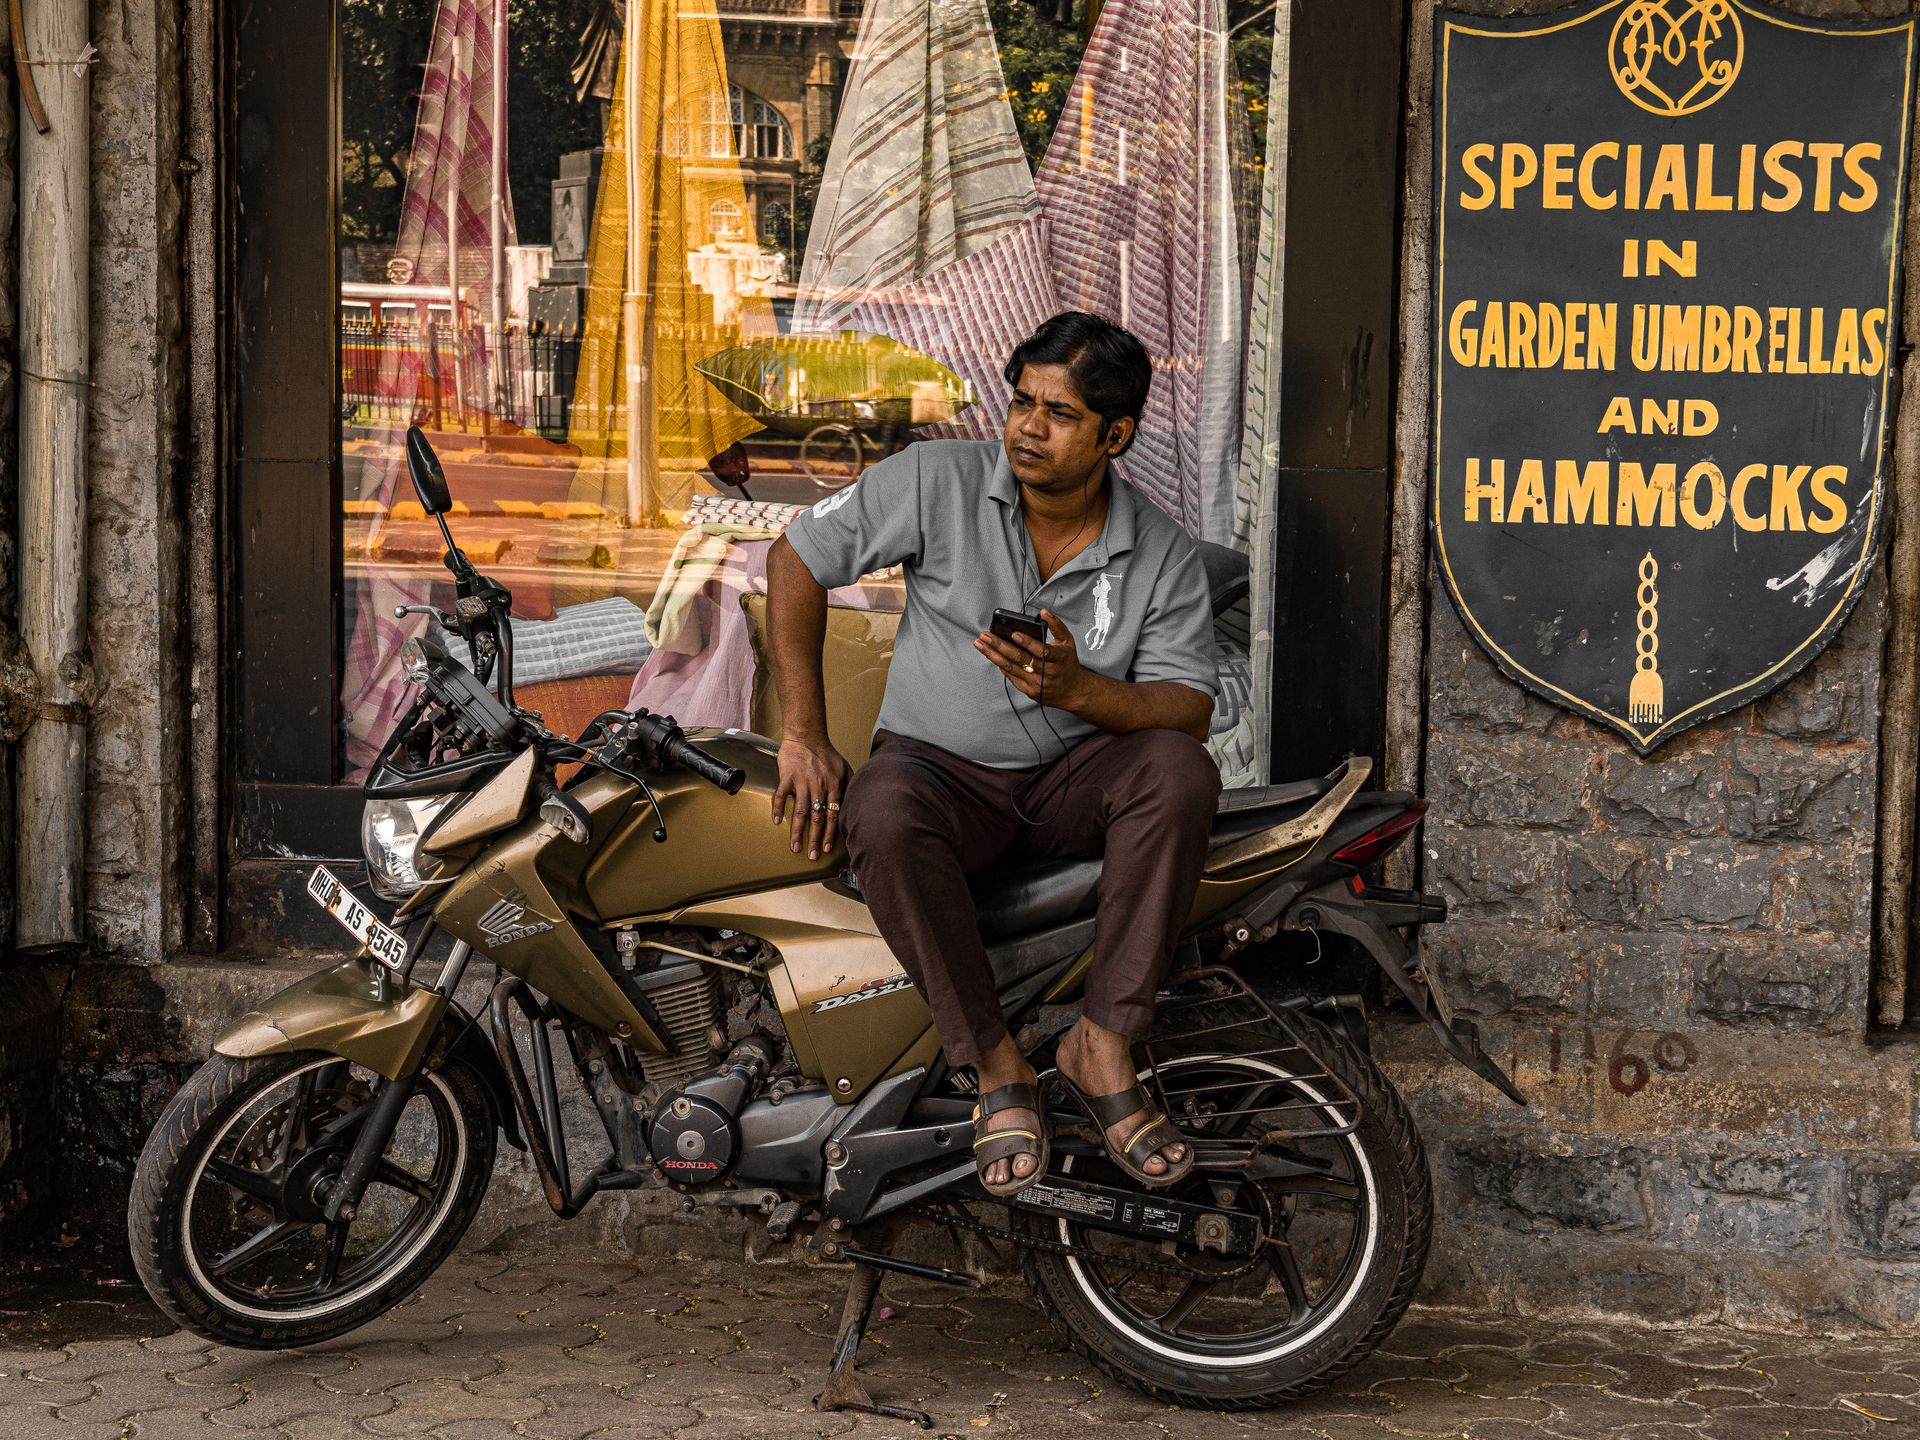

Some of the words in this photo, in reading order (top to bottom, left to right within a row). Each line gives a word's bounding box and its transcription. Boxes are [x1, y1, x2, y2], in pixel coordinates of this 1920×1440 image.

[1460, 141, 1882, 212] SPECIALISTS
[1622, 239, 1697, 278] IN
[1449, 300, 1617, 370] GARDEN
[1631, 304, 1886, 377] UMBRELLAS
[1597, 397, 1719, 436] AND
[1464, 458, 1849, 533] HAMMOCKS
[344, 902, 364, 930] AS
[485, 921, 554, 948] HONDA
[665, 1160, 718, 1169] HONDA
